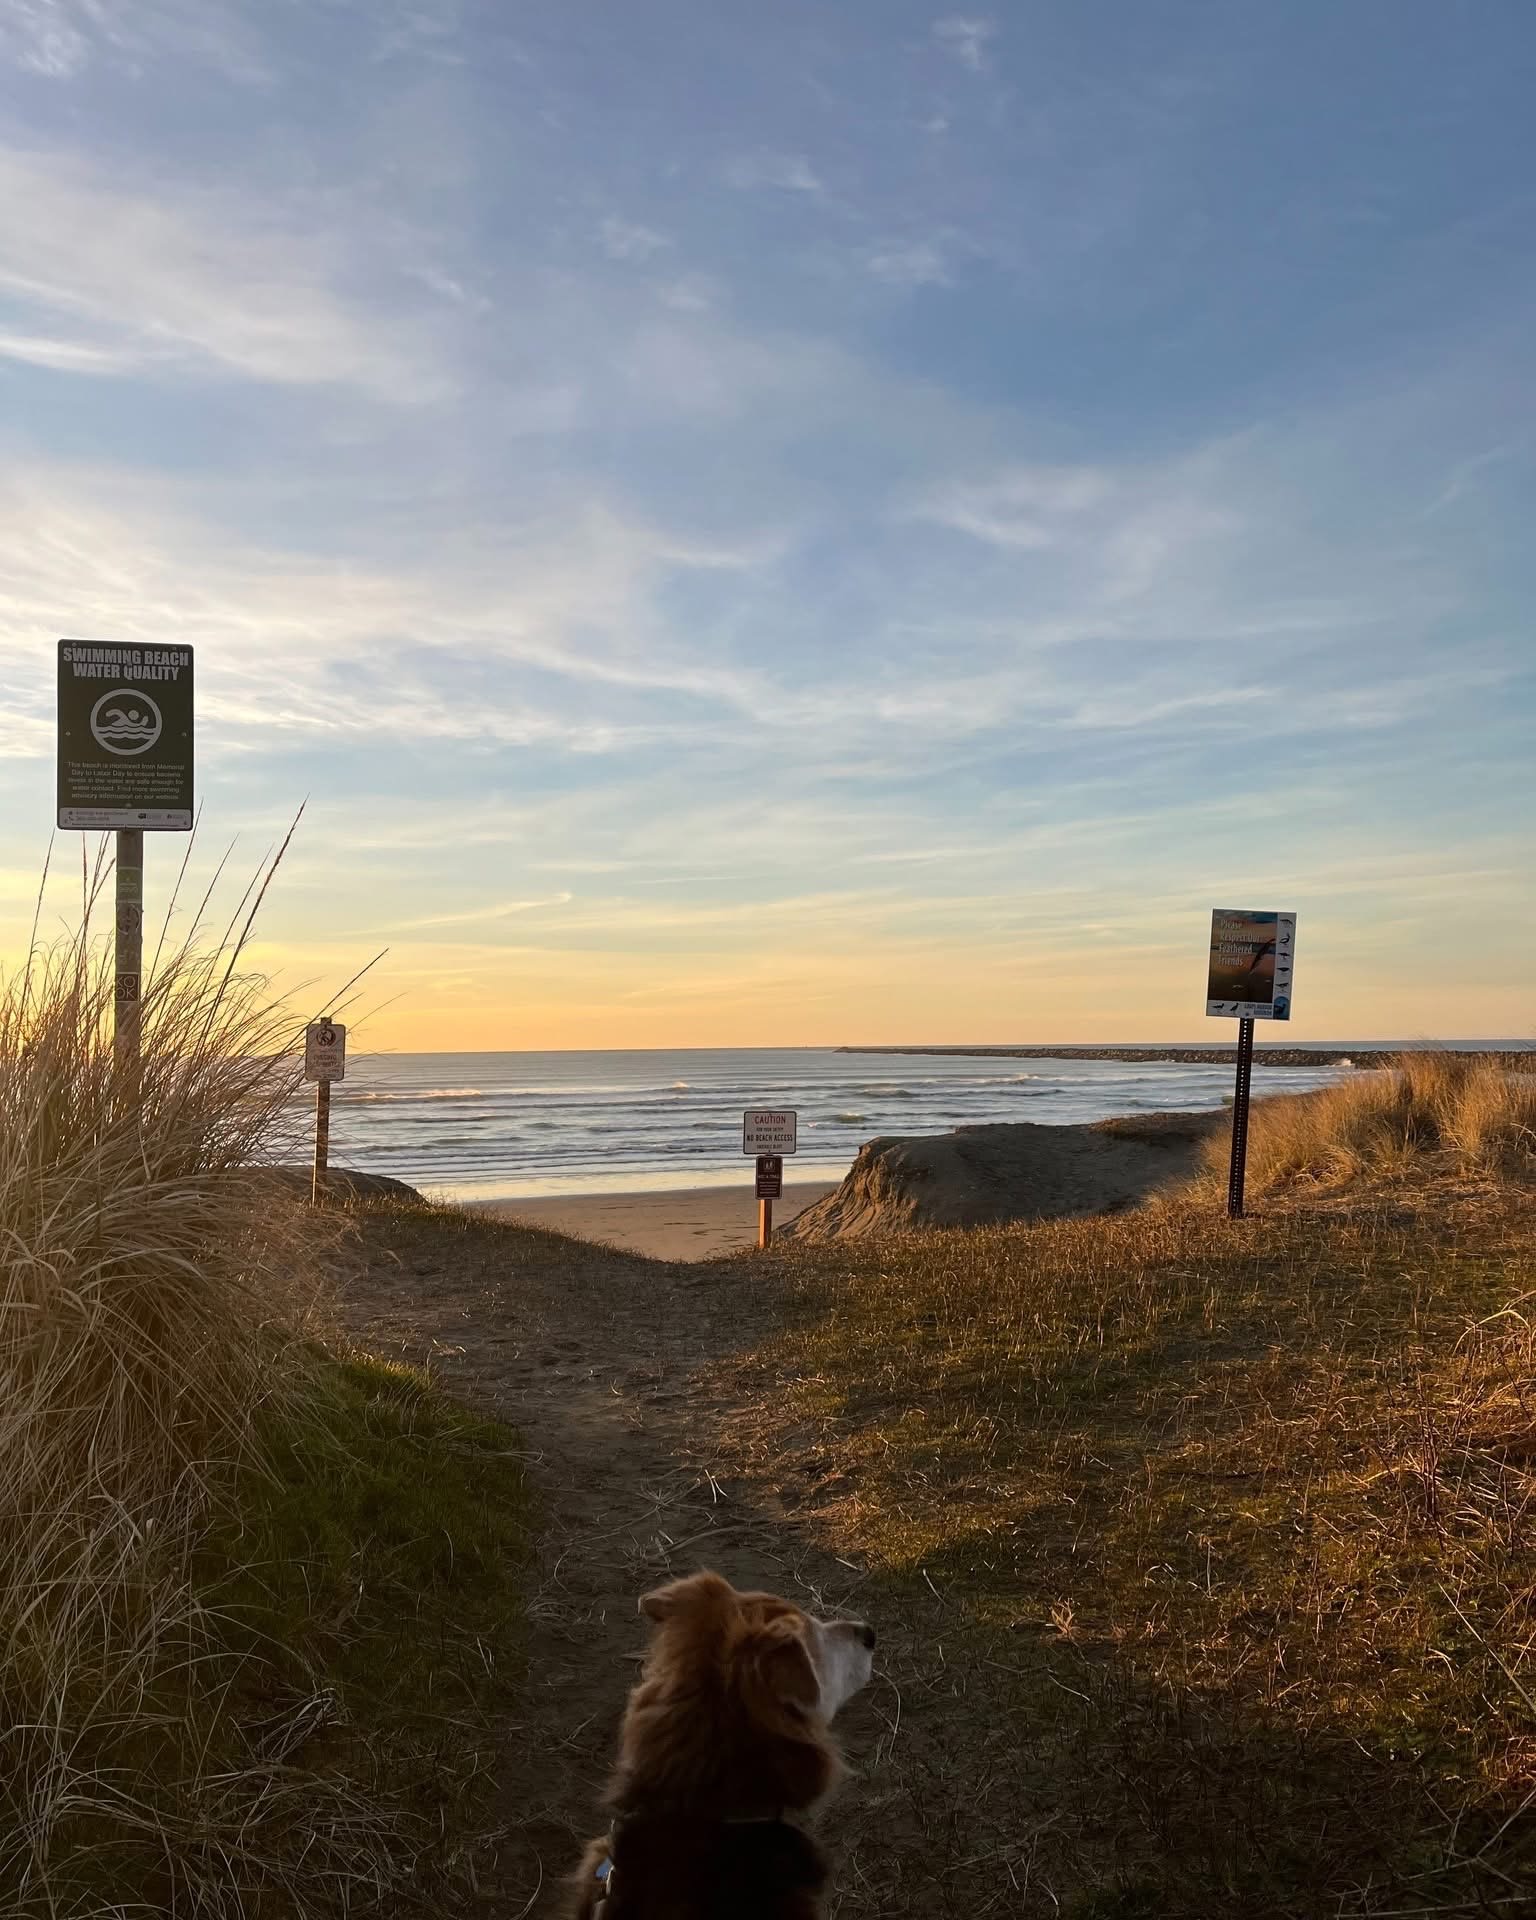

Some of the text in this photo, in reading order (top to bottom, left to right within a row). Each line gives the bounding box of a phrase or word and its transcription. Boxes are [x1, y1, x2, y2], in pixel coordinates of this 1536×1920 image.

[63, 647, 189, 666] SWIMMING BEACH
[73, 663, 180, 680] WATER QUALITY
[1220, 920, 1242, 929] Please
[1219, 943, 1252, 954] Feathered
[1218, 954, 1244, 966] Friends
[754, 1116, 786, 1124] CAUTION
